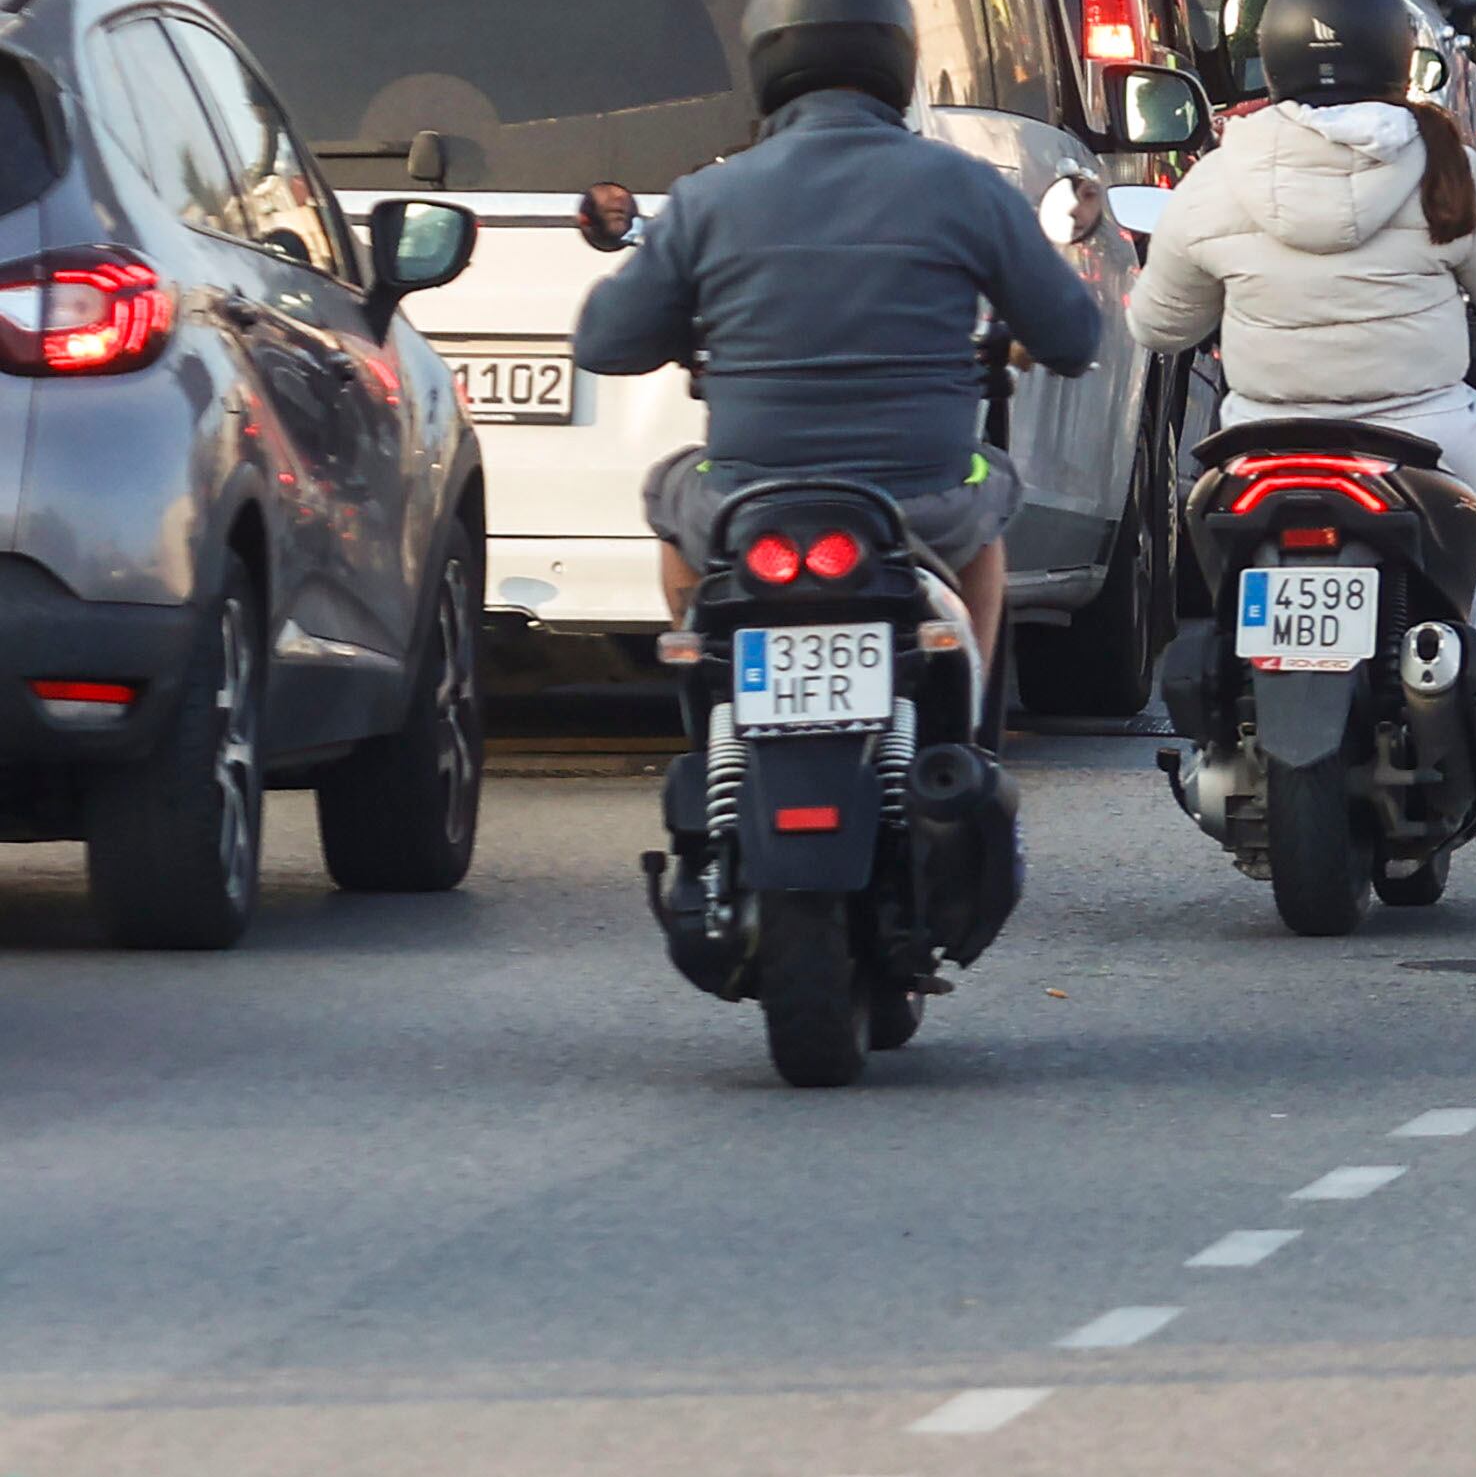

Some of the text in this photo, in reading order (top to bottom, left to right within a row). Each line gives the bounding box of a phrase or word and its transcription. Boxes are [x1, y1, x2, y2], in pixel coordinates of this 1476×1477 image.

[1248, 604, 1262, 618] E
[1275, 578, 1365, 611] 4598
[1272, 614, 1340, 647] MBD
[772, 633, 881, 672] 3366
[744, 668, 762, 682] E
[773, 674, 853, 715] HFR
